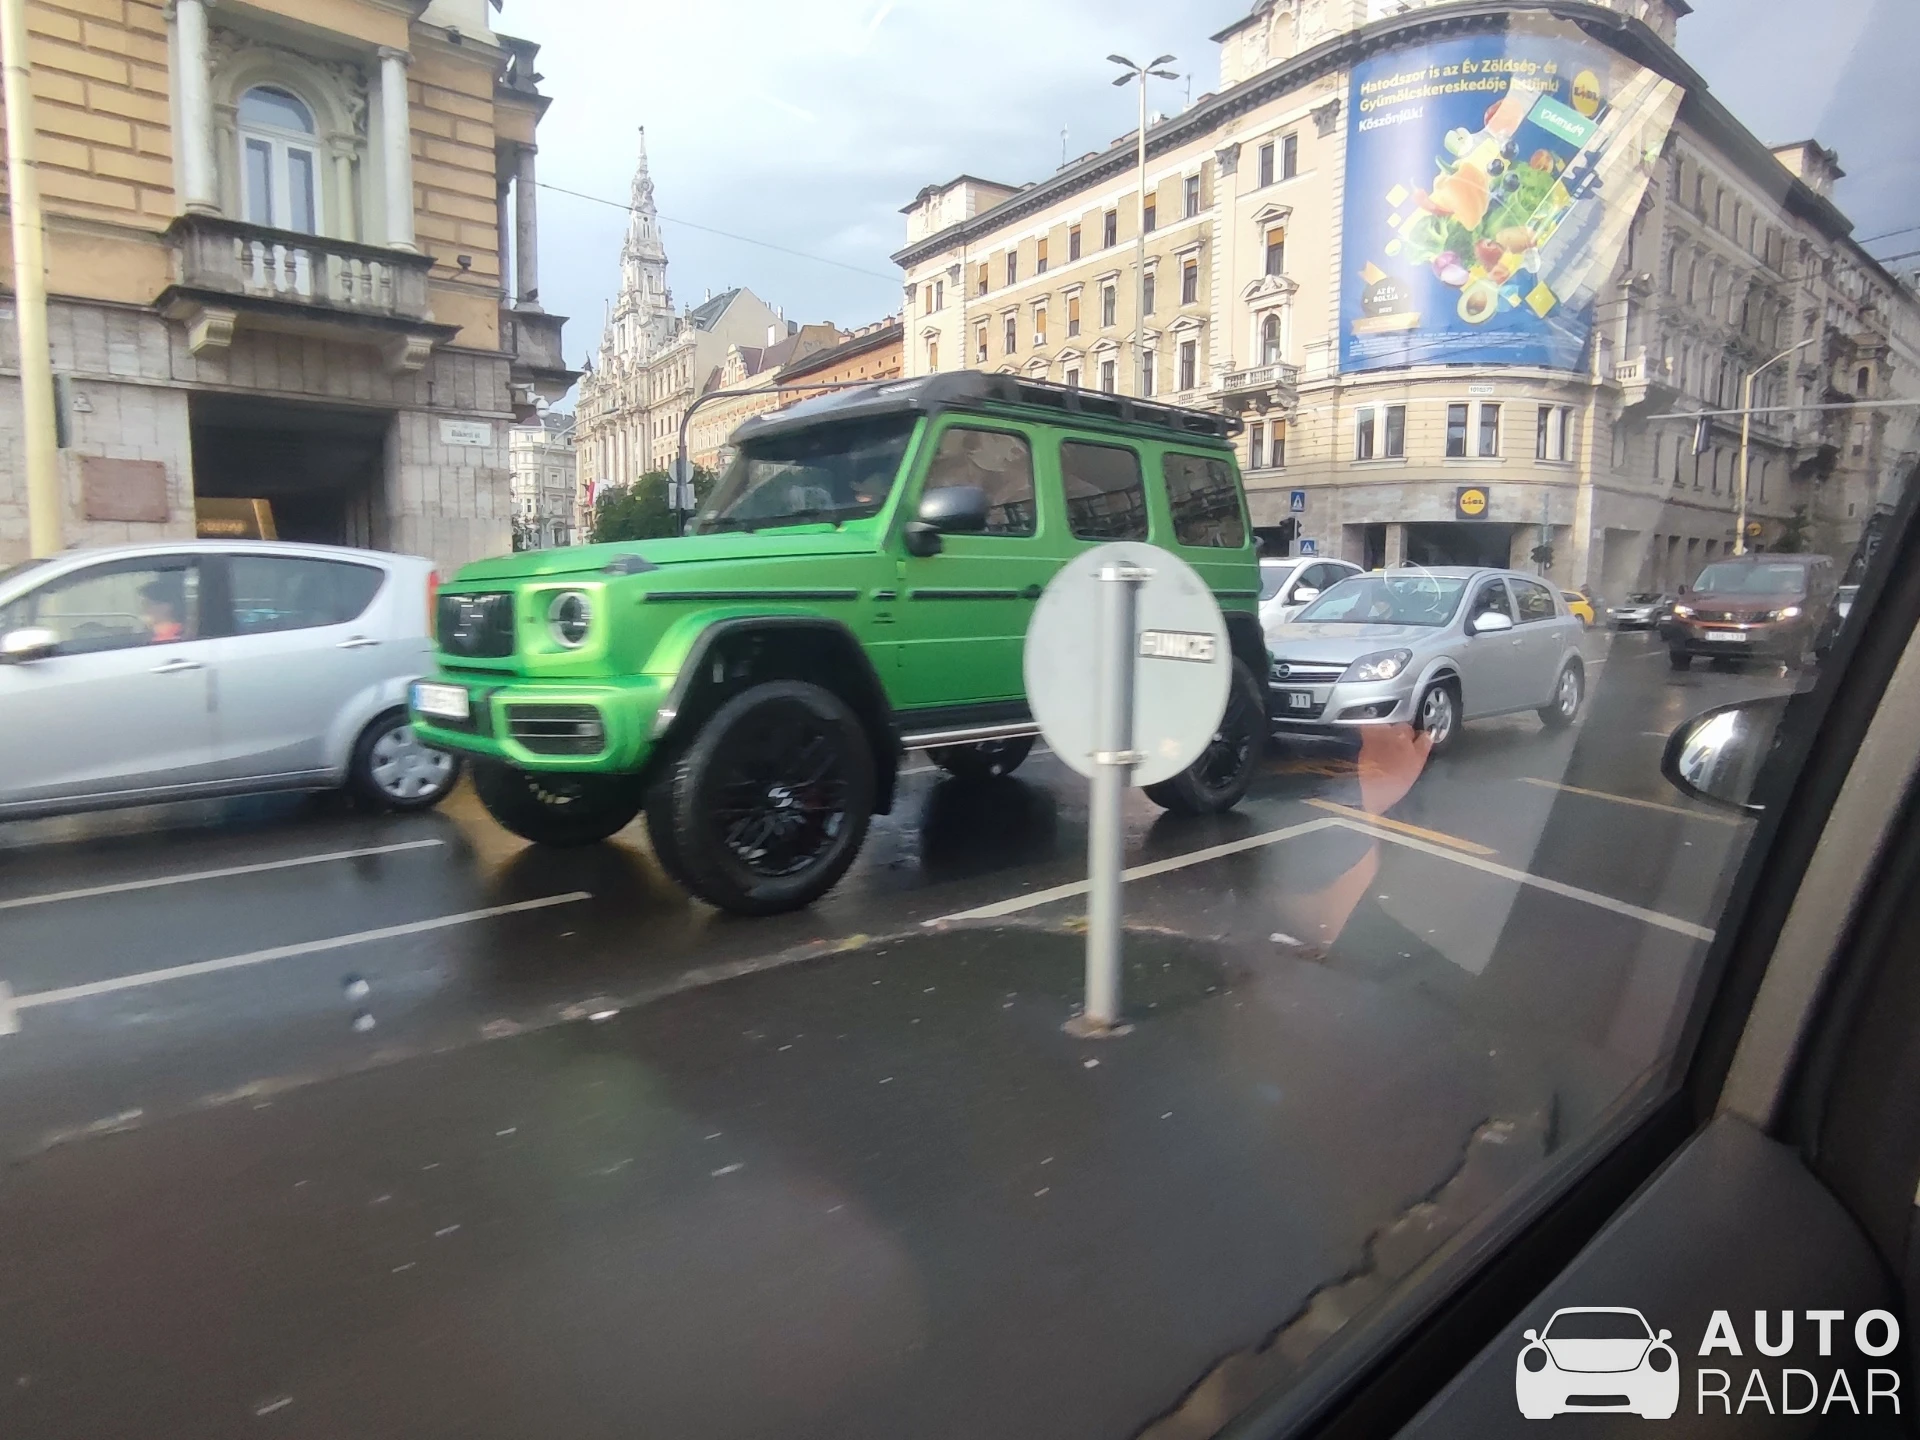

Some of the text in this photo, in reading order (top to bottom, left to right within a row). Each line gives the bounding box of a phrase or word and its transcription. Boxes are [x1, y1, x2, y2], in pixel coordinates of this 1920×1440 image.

[1361, 57, 1557, 96] Hatodszor is az Év Zöldség- és
[1360, 77, 1506, 112] Gyümölcskereskedője
[1359, 106, 1424, 132] Köszönjük!
